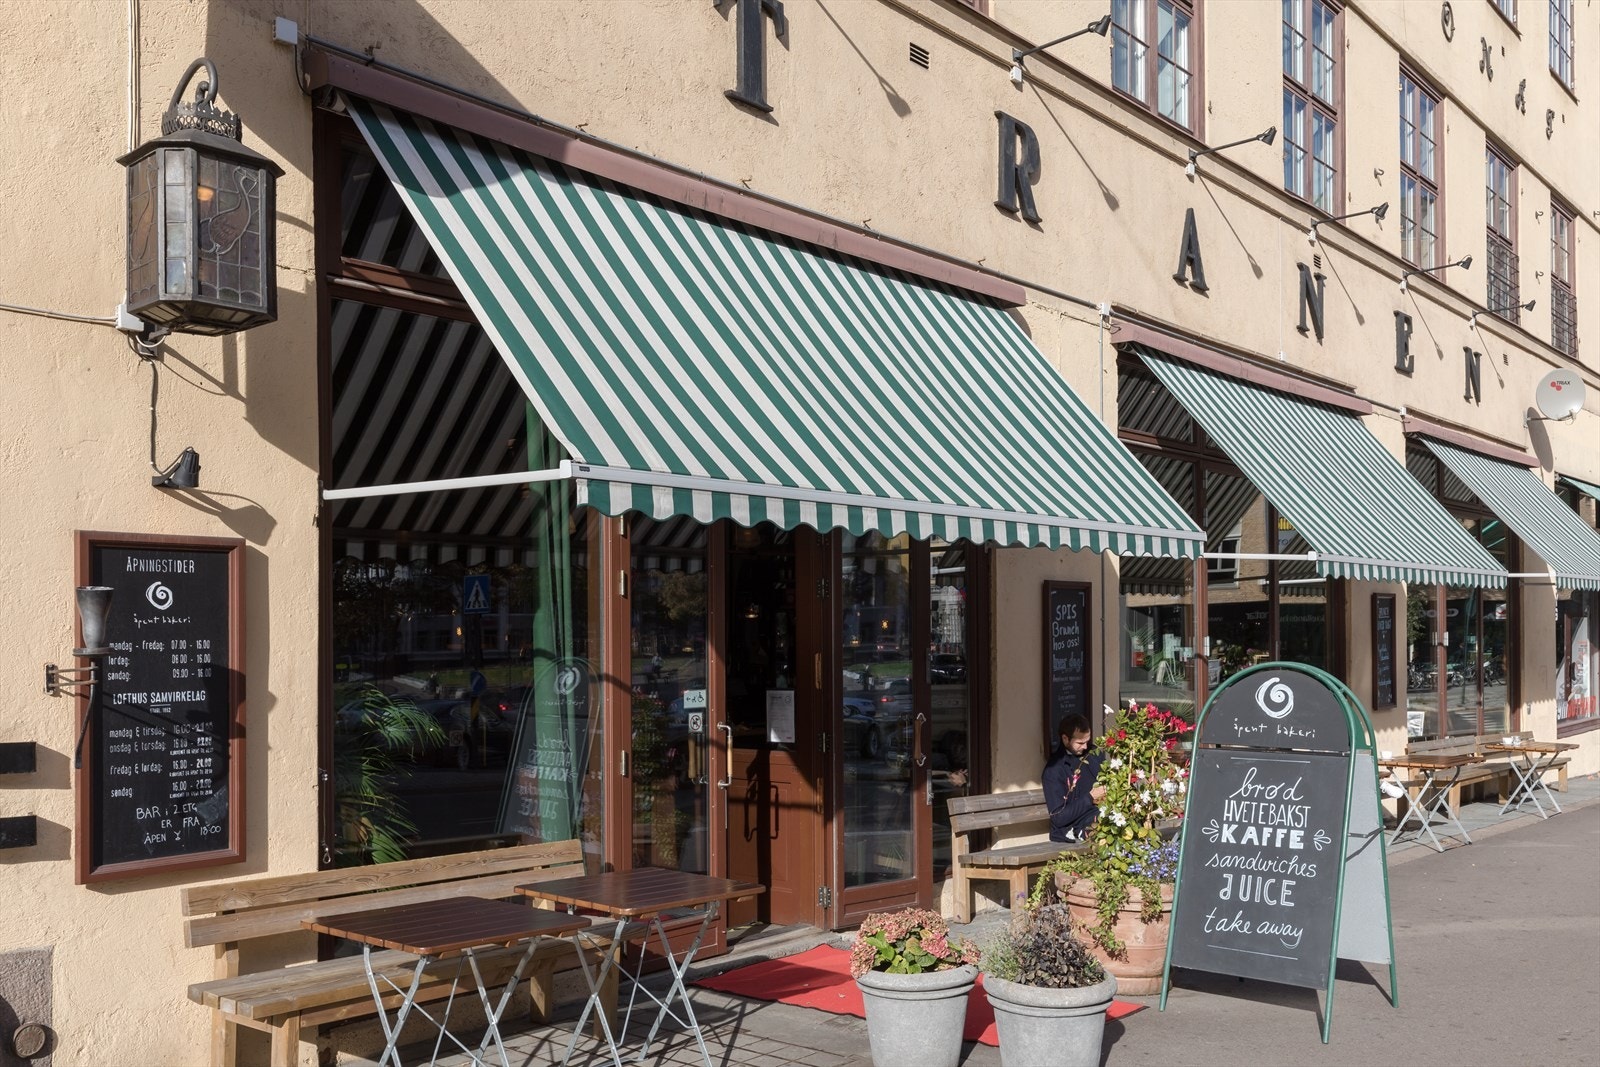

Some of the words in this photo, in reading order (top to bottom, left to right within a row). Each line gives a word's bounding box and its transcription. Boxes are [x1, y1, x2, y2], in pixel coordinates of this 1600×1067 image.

[126, 556, 195, 573] ÅPNINGSTIDER
[1056, 604, 1077, 621] SPIS
[1052, 621, 1080, 638] Brunch
[1053, 638, 1065, 651] hos
[113, 692, 148, 705] LOFTHUS
[150, 690, 206, 704] SAMVIRKELAG
[109, 728, 133, 739] mandag
[1233, 718, 1268, 737] åpent
[1277, 725, 1316, 738] bakeri
[110, 743, 131, 754] onsdag
[110, 765, 132, 776] fredag
[1229, 767, 1304, 801] brød
[136, 806, 161, 820] BAR
[173, 804, 180, 814] 2
[182, 802, 198, 813] ETG
[1223, 800, 1311, 828] HVETEBAKST
[161, 820, 173, 828] ER
[183, 816, 200, 828] FRA
[144, 832, 167, 844] ÅPEN
[1221, 824, 1304, 849] KAFFE
[1205, 851, 1317, 878] sandwiches
[1219, 873, 1296, 907] JUICE
[1204, 907, 1252, 934] take
[1256, 919, 1304, 949] away
